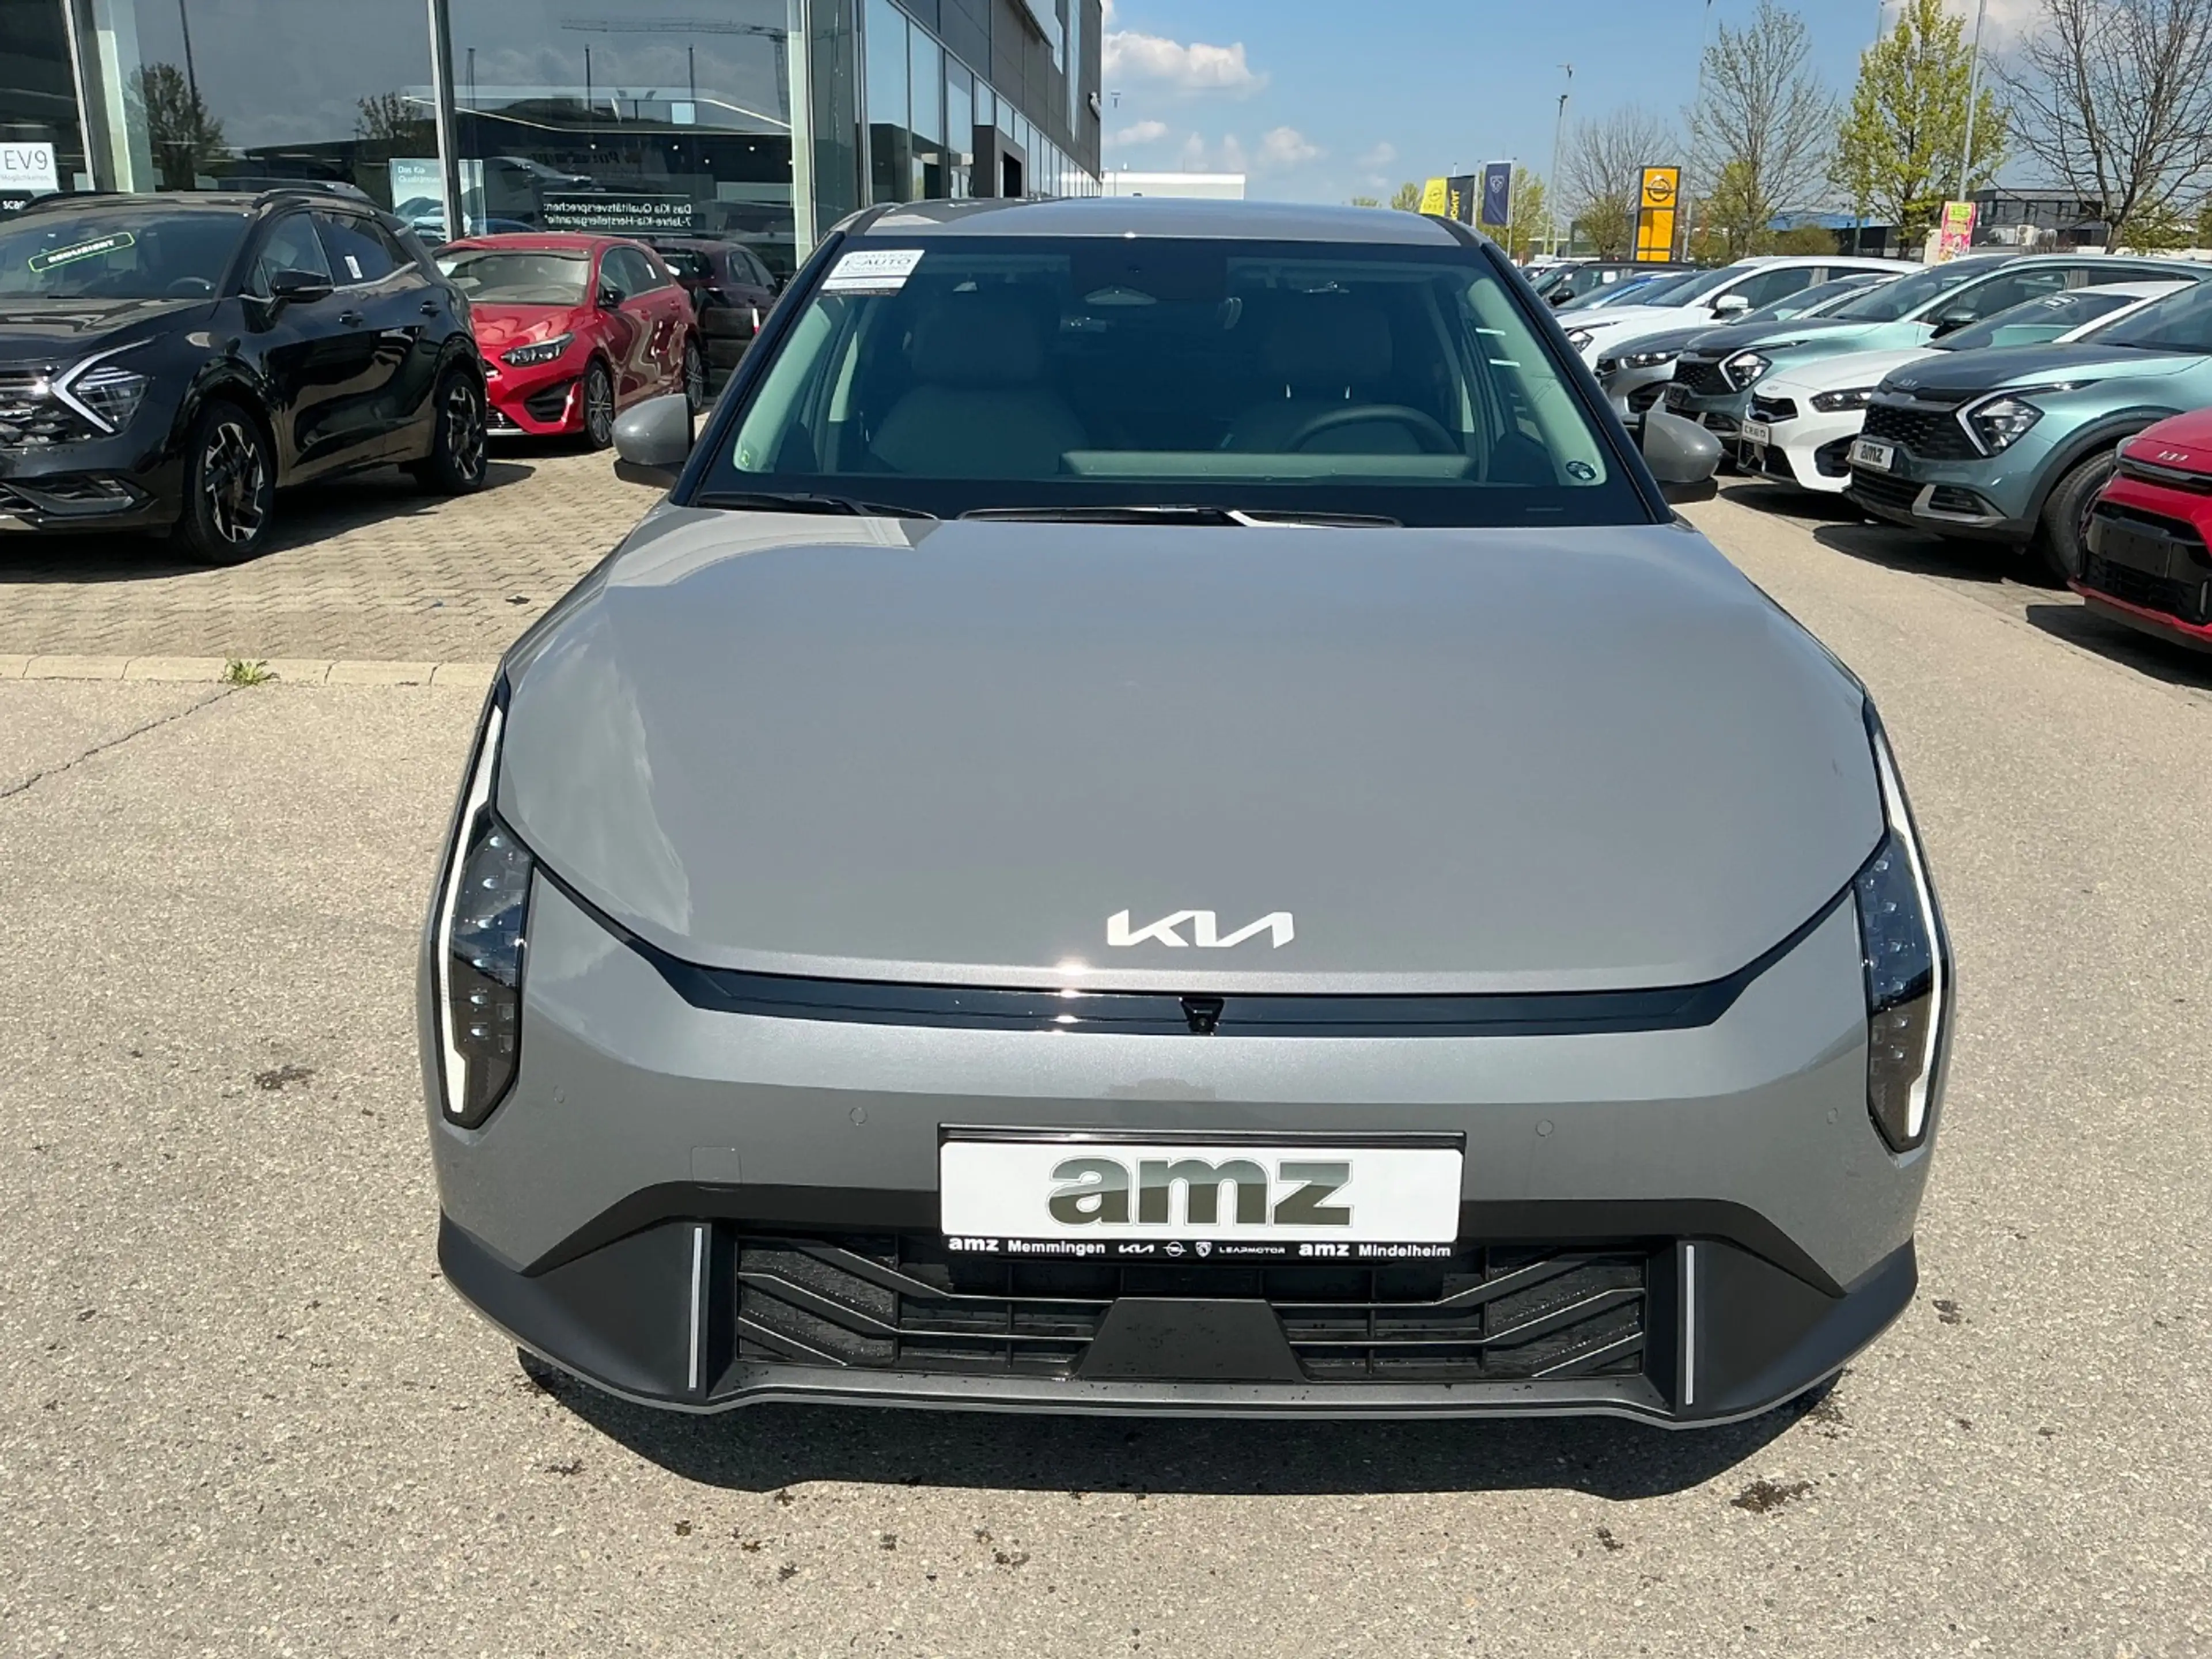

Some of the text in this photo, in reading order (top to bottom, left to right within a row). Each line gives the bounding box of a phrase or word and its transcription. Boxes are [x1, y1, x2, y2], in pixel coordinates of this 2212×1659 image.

[4, 150, 48, 170] EV9
[1860, 444, 1884, 464] amz
[1107, 909, 1295, 949] KIA
[1046, 1155, 1355, 1228] amz
[948, 1237, 999, 1251] amz
[1007, 1240, 1106, 1256] Memmingen
[1299, 1243, 1350, 1257] amz
[1358, 1244, 1452, 1257] Mindelheim
